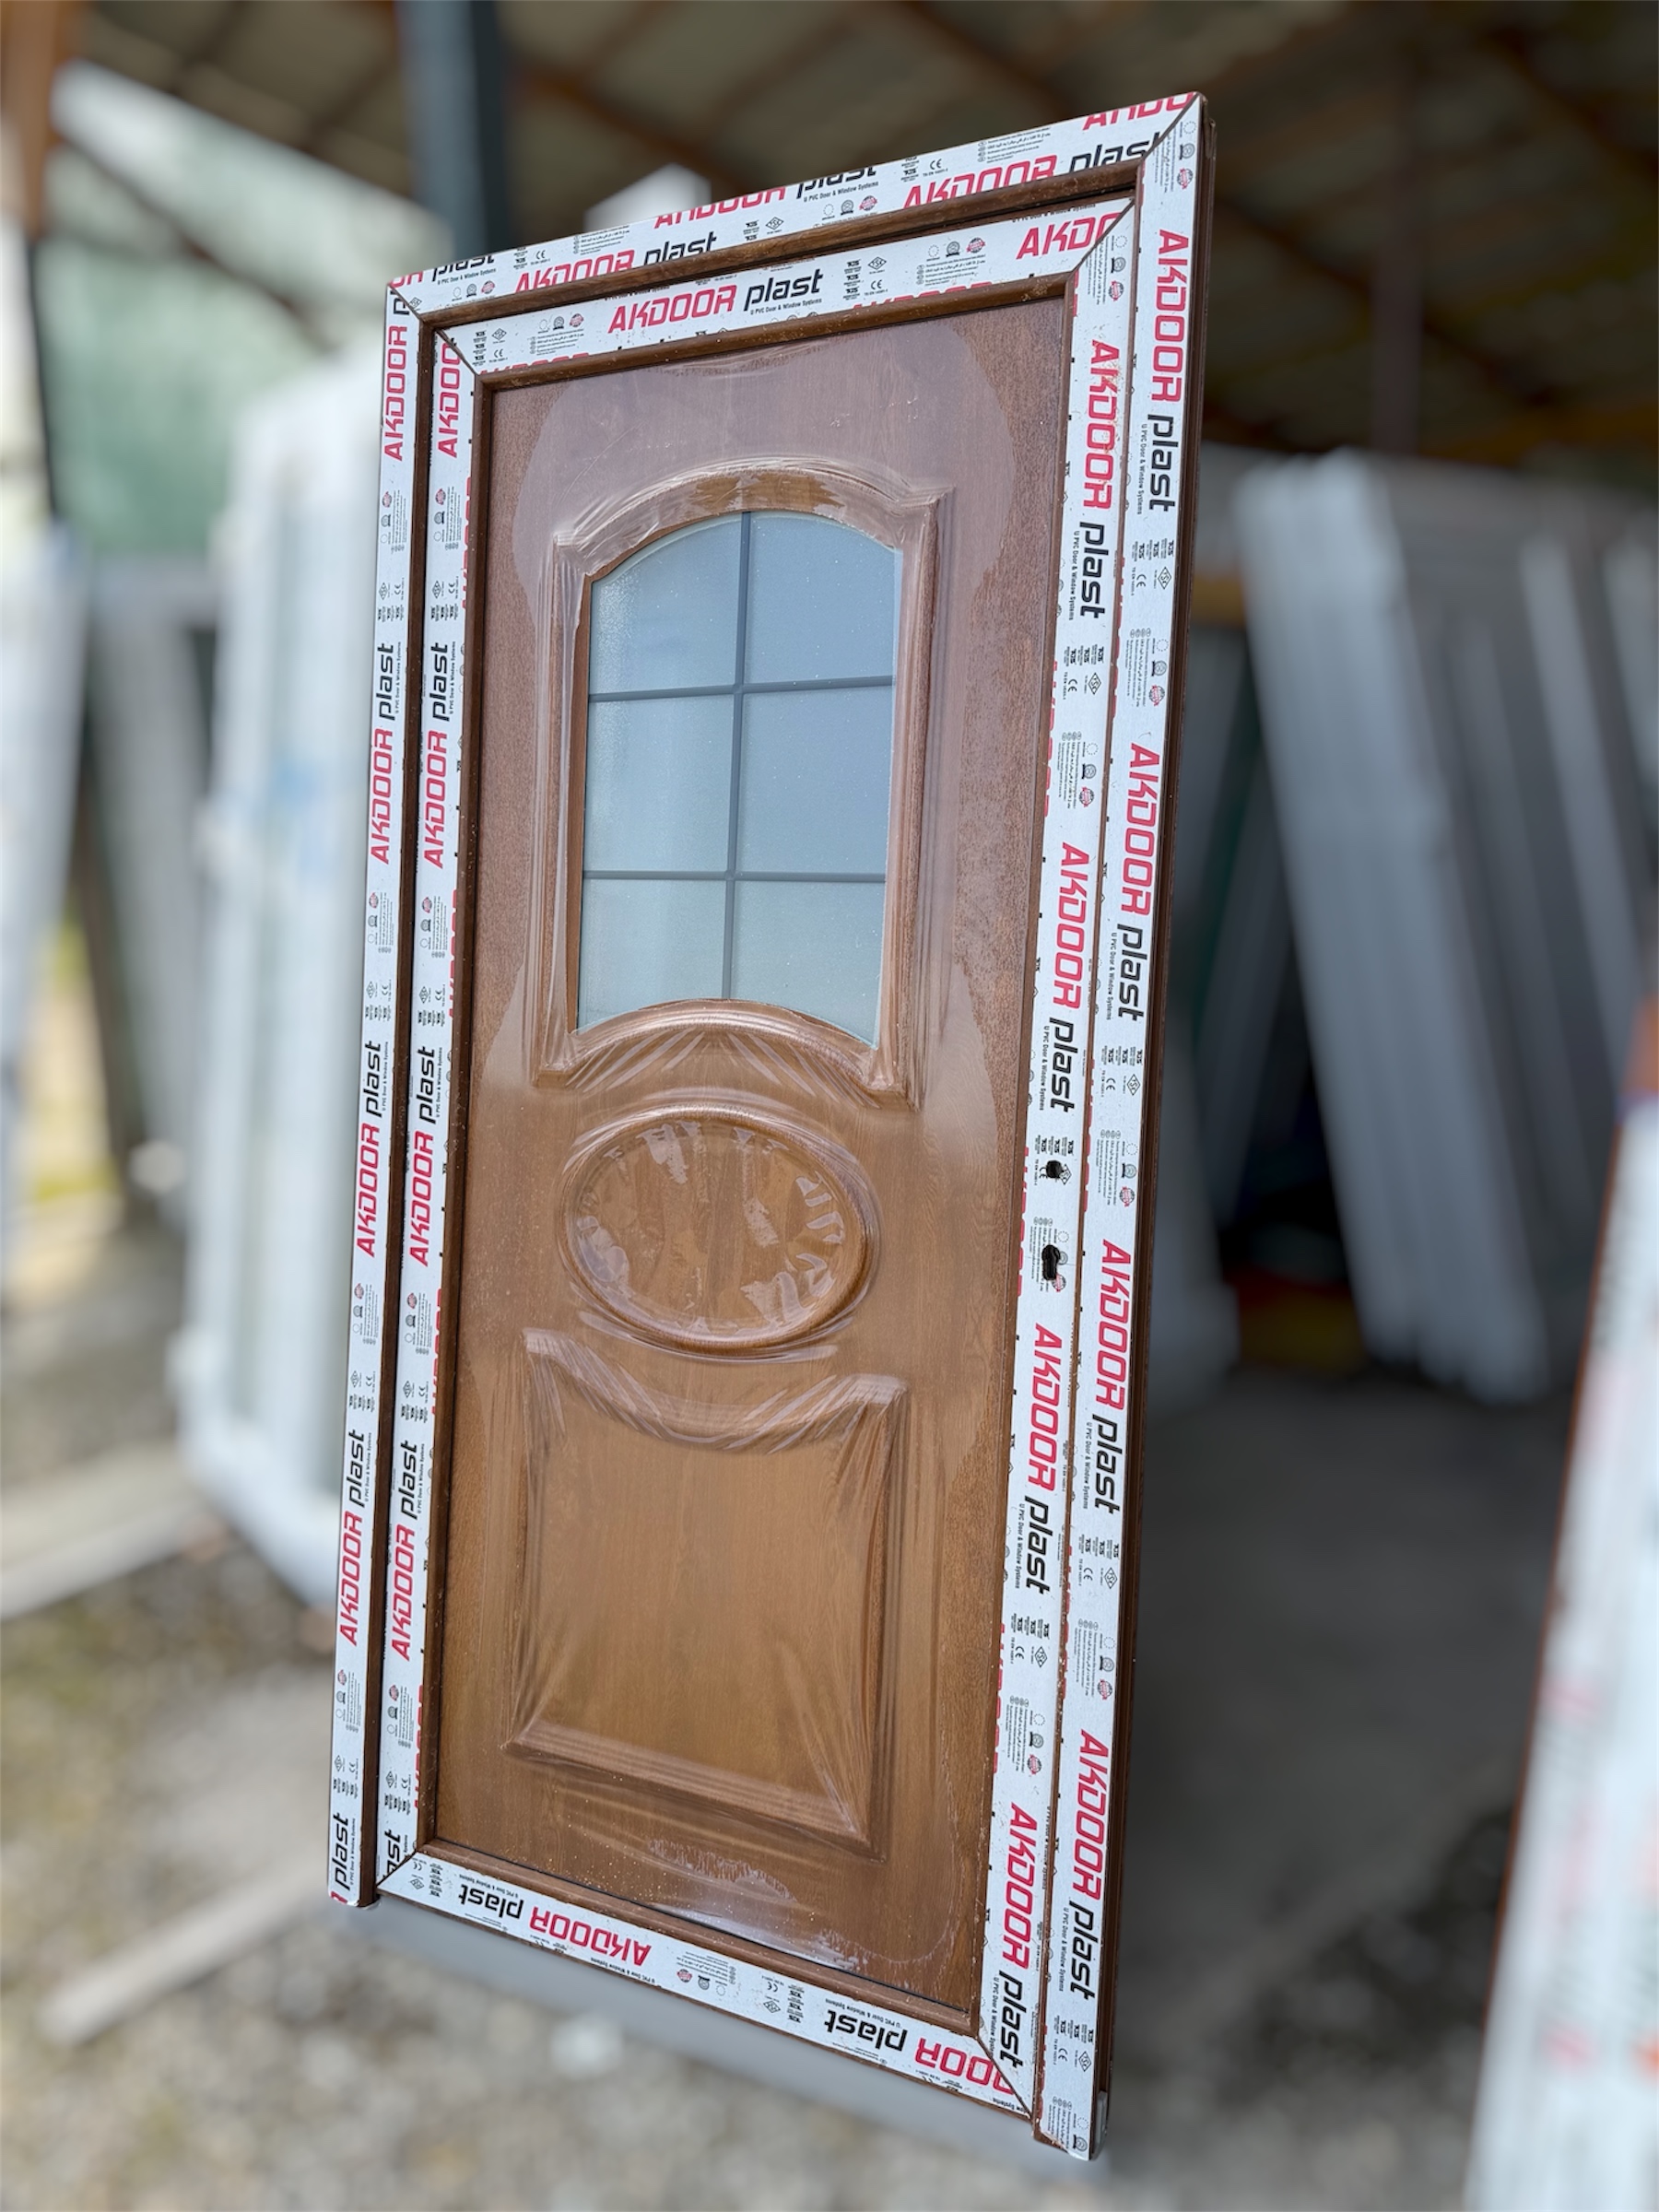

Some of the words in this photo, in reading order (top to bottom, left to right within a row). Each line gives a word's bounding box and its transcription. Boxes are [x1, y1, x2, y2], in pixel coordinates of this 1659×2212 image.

[904, 155, 1057, 208] AKDOOR
[930, 159, 943, 170] CE
[516, 250, 634, 292] AKDOOR
[642, 231, 717, 267] plast
[535, 250, 546, 260] CE
[870, 279, 883, 289] CE
[608, 285, 736, 333] AKDOOR
[743, 267, 824, 312] plast
[1151, 229, 1188, 402] AKDOOR
[384, 325, 406, 460] AKDOOR
[493, 348, 504, 359] CE
[1083, 340, 1120, 510] AKDOOR
[1139, 443, 1147, 458] Door
[1147, 414, 1179, 512] plast
[1136, 489, 1145, 515] Systems
[1068, 595, 1077, 621] Systems
[1079, 522, 1109, 618] plast
[1136, 573, 1147, 587] CE
[375, 642, 395, 721] plast
[429, 642, 450, 722] plast
[1067, 678, 1077, 692] CE
[371, 728, 392, 863] AKDOOR
[423, 730, 446, 867] AKDOOR
[1121, 744, 1159, 915] AKDOOR
[1053, 842, 1089, 1009] AKDOOR
[1109, 951, 1117, 965] Door
[1106, 996, 1114, 1020] Systems
[1117, 924, 1148, 1021] plast
[363, 1041, 382, 1118] plast
[416, 1046, 436, 1124] plast
[1039, 1088, 1047, 1111] Systems
[1049, 1017, 1078, 1112] plast
[1105, 1077, 1116, 1091] CE
[356, 1123, 379, 1256] AKDOOR
[408, 1130, 433, 1265] AKDOOR
[1095, 1240, 1131, 1410] AKDOOR
[1028, 1324, 1062, 1491] AKDOOR
[346, 1430, 365, 1508] plast
[398, 1440, 418, 1520] plast
[1082, 1485, 1090, 1510] Systems
[1092, 1414, 1123, 1514] plast
[339, 1512, 360, 1644] AKDOOR
[1014, 1565, 1022, 1589] Systems
[1024, 1495, 1053, 1594] plast
[1083, 1567, 1093, 1582] CE
[391, 1524, 414, 1659] AKDOOR
[1015, 1645, 1025, 1660] CE
[332, 1812, 350, 1891] plast
[1072, 1730, 1109, 1900] AKDOOR
[459, 1884, 524, 1920] plast
[1002, 1803, 1037, 1969] AKDOOR
[529, 1908, 650, 1966] AKDOOR
[1068, 1900, 1099, 2000] plast
[998, 1970, 1027, 2068] plast
[1058, 1968, 1066, 1992] Systems
[824, 2009, 908, 2052] plast
[1058, 2048, 1069, 2062] CE
